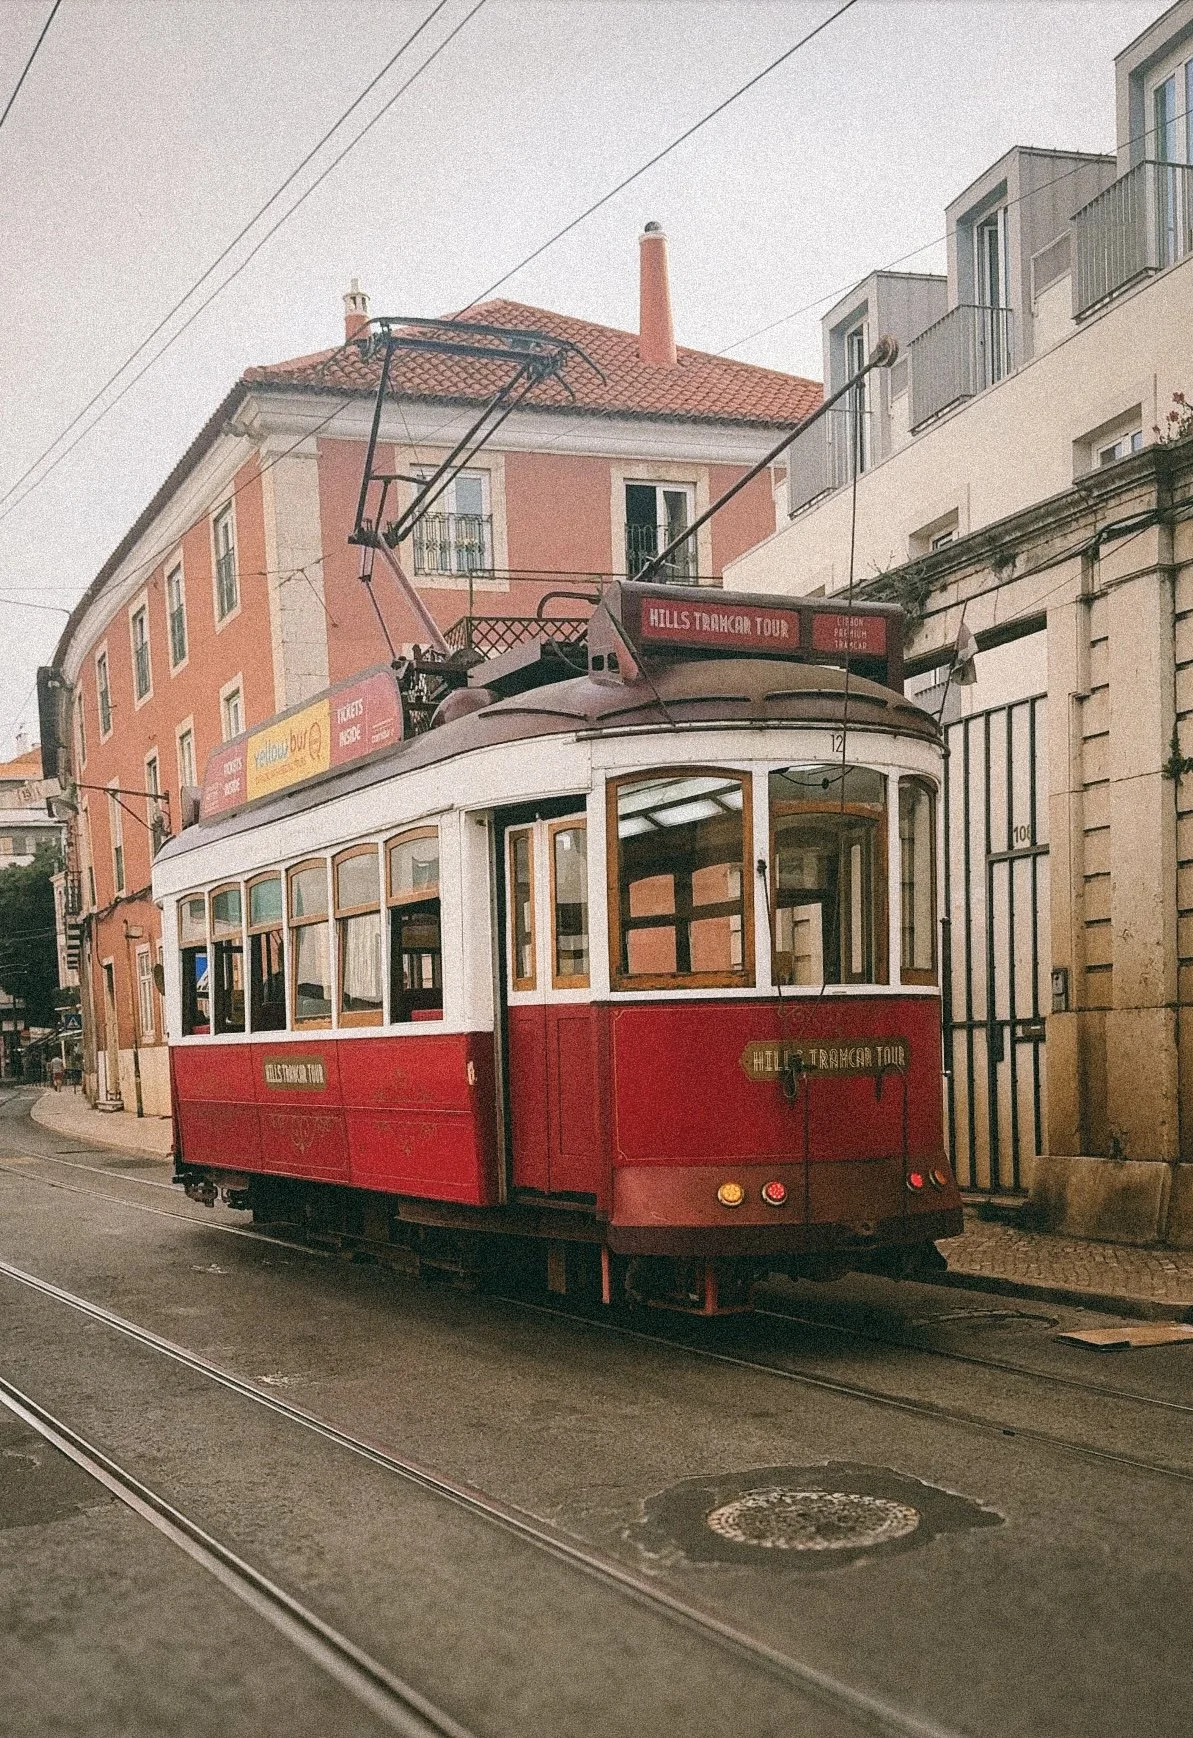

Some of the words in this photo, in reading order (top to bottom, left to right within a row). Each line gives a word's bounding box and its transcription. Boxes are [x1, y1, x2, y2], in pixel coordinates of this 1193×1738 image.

[649, 608, 690, 630] HILLS
[694, 611, 752, 635] TRAMCAR
[755, 617, 789, 639] TOUR
[337, 698, 363, 724] TICKETS
[831, 734, 843, 753] 12
[753, 1050, 804, 1072] HILL
[809, 1047, 872, 1069] TRAMCAR
[877, 1046, 906, 1067] TOUR
